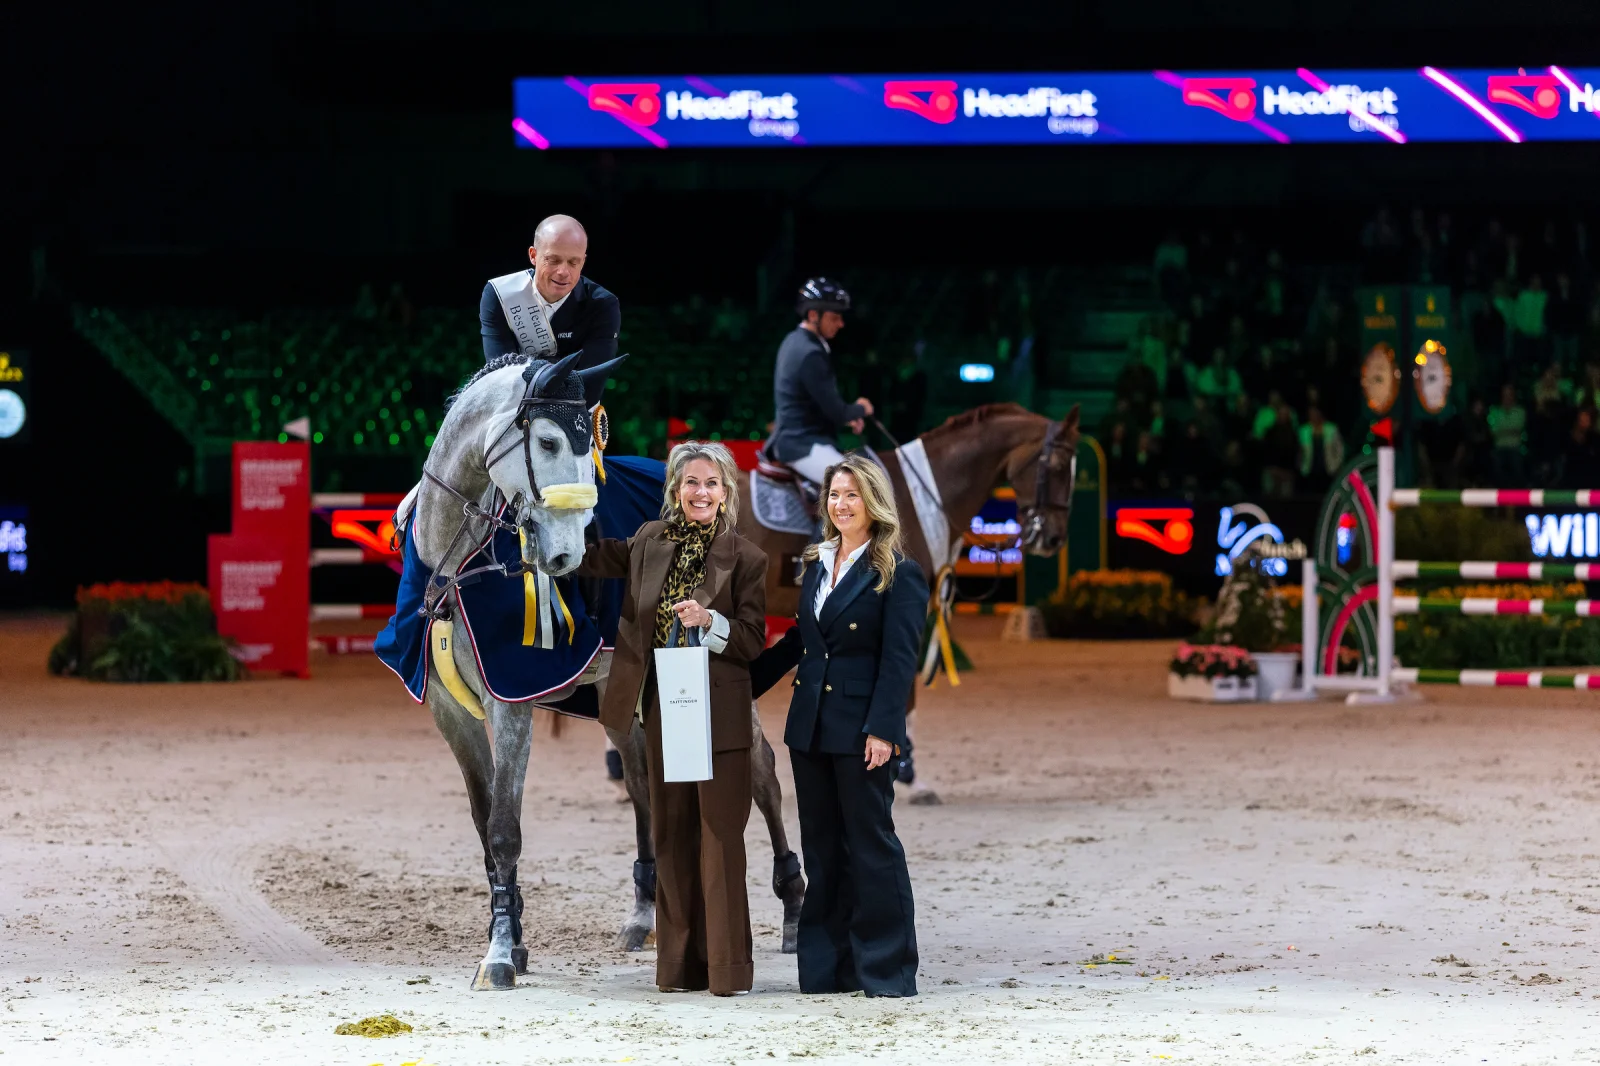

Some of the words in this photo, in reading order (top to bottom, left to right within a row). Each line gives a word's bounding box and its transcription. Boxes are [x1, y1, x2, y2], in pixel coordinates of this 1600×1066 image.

[665, 90, 799, 121] HeadFirst
[963, 87, 1099, 118] HeadFirst
[1262, 84, 1399, 116] HeadFirst
[509, 304, 526, 331] Best
[1525, 512, 1600, 557] Wil
